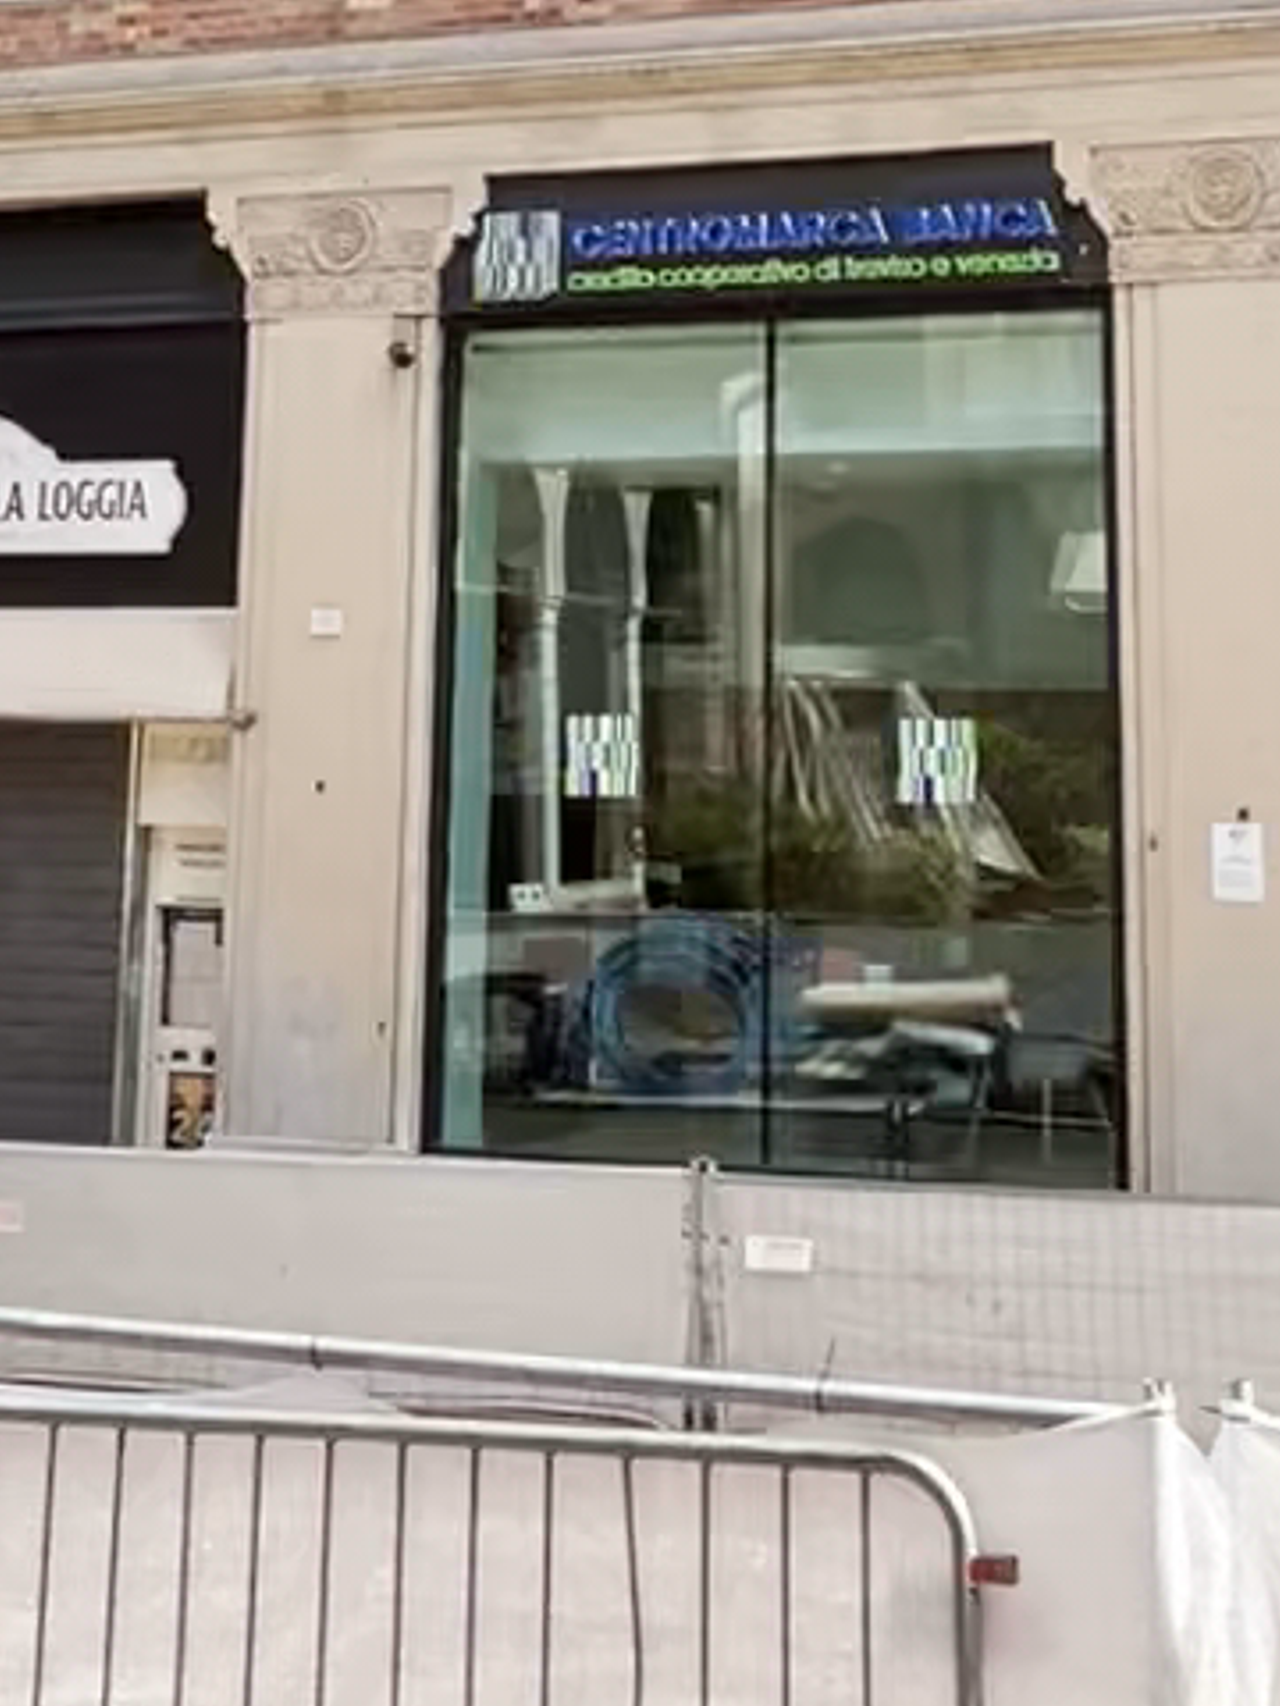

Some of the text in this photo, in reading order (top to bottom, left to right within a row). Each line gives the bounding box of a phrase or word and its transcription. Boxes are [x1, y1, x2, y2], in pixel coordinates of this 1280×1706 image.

[573, 199, 1058, 260] CENTROMARCA BANCA
[568, 246, 1061, 291] credito cooperativo di treviso e venezia
[37, 479, 148, 521] LOGGIA
